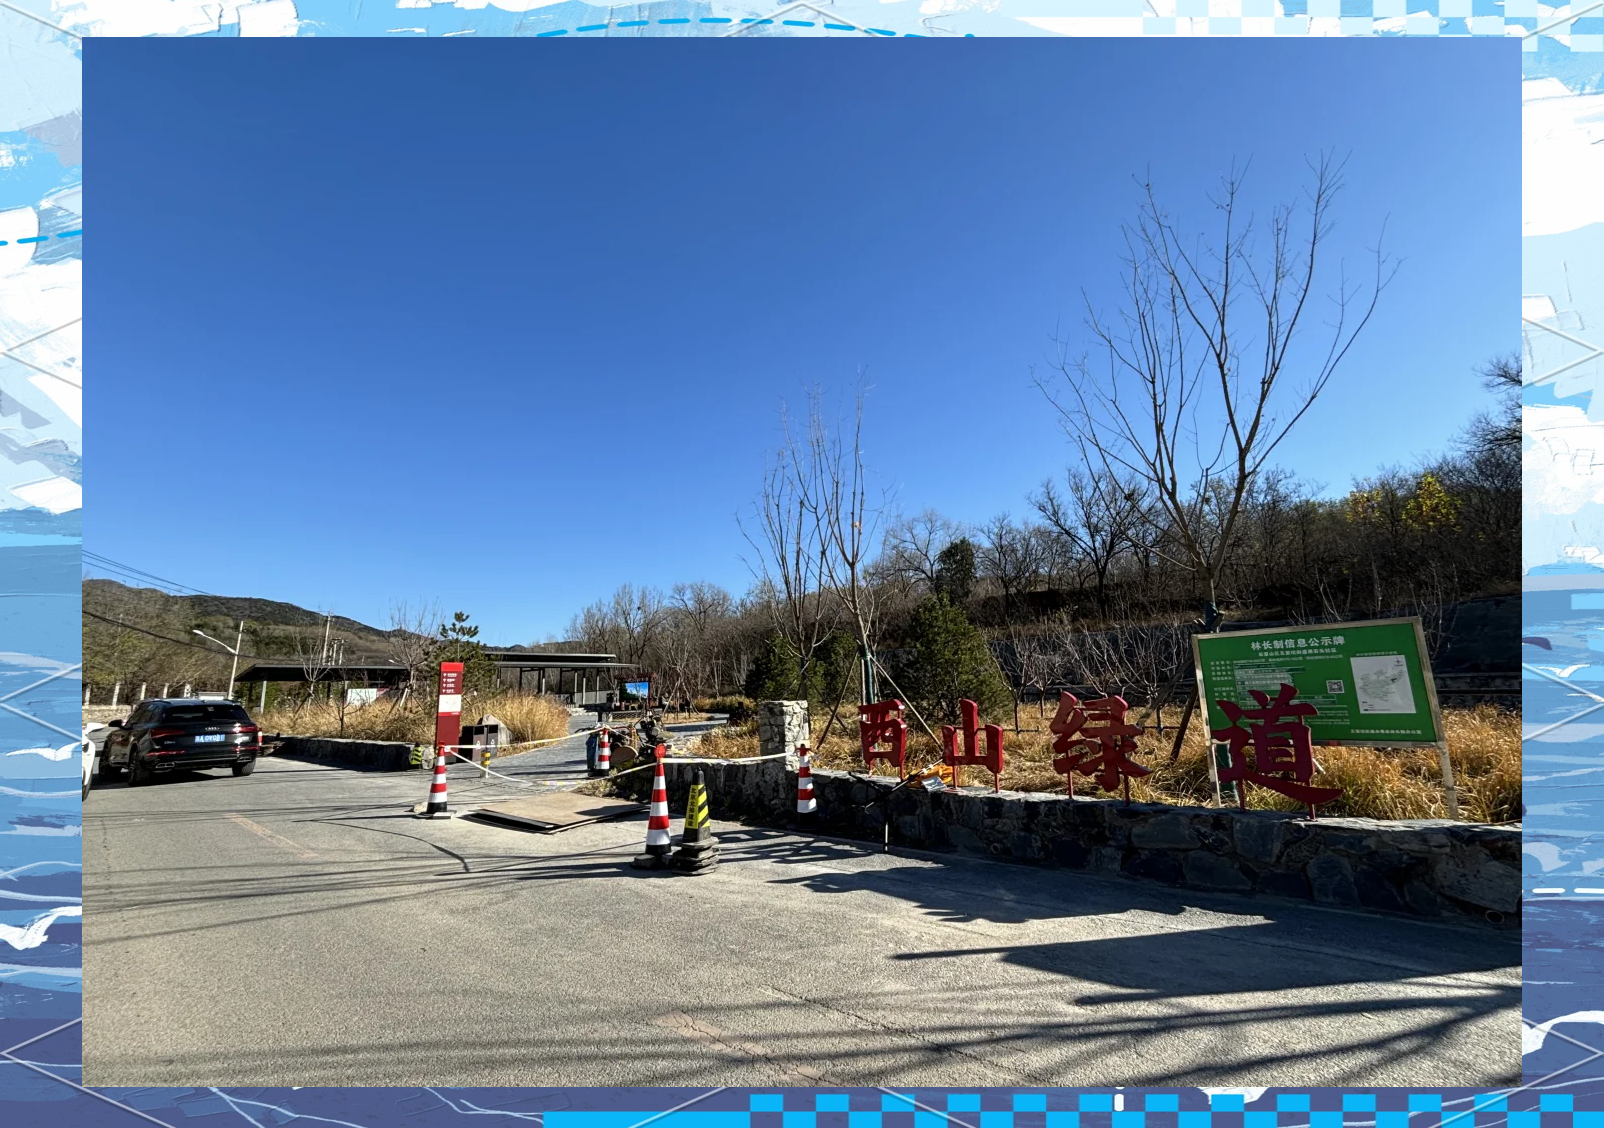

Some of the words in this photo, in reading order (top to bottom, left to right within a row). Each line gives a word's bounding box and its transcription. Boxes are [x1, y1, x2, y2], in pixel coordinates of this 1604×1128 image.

[1250, 635, 1346, 651] 林长制信息公示牌
[858, 683, 1345, 805] 西山绿道
